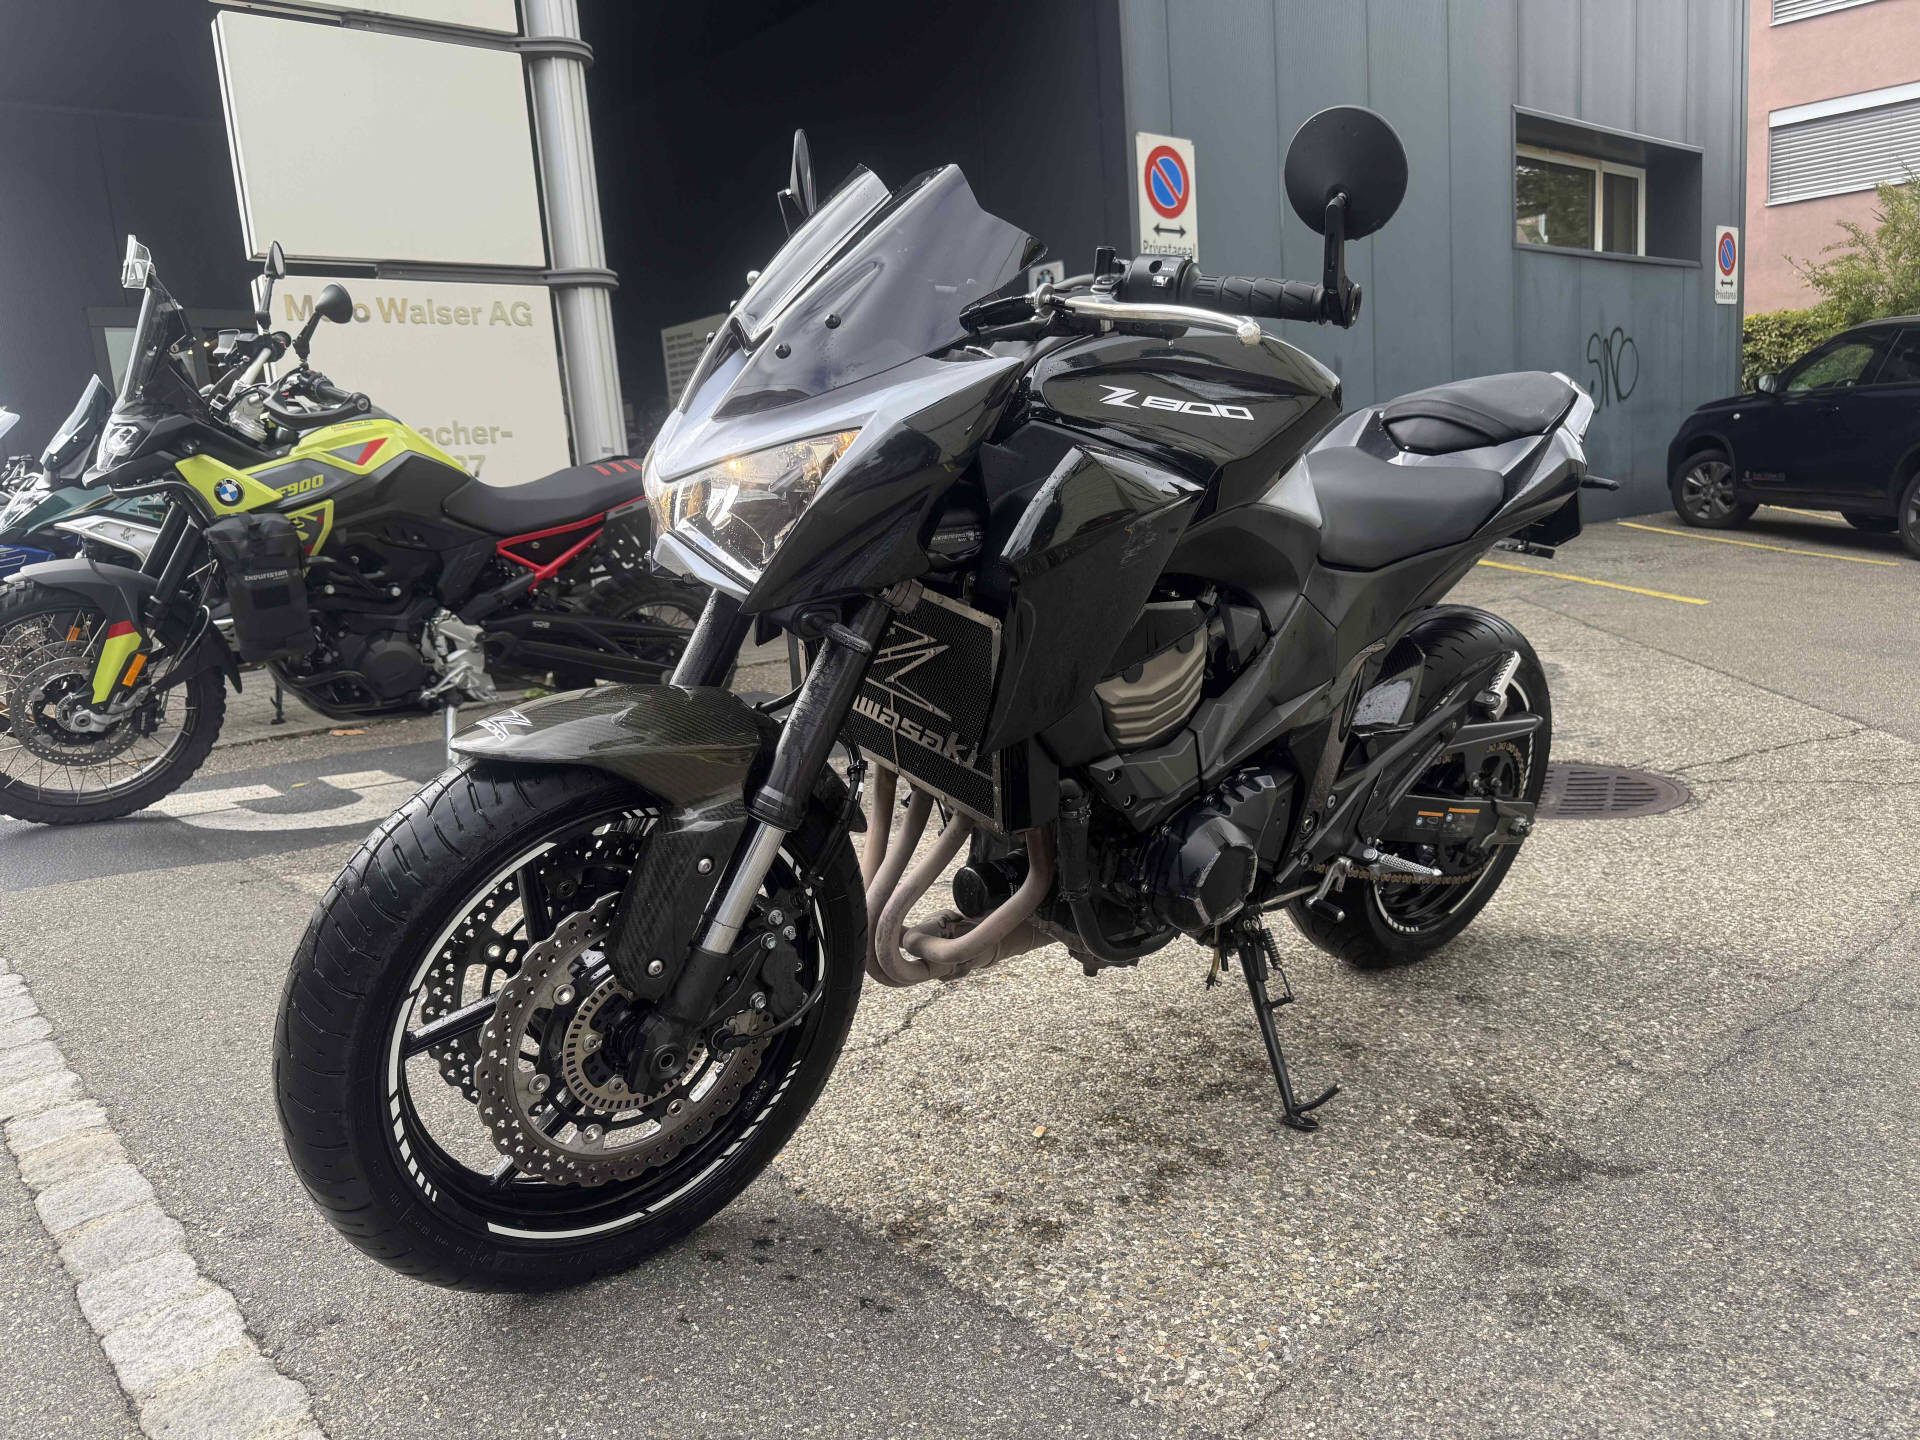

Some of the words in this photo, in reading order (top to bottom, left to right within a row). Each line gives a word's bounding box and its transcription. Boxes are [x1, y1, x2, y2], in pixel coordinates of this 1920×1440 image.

[284, 294, 371, 324] Mo
[376, 297, 483, 326] Walser
[488, 300, 533, 327] AG
